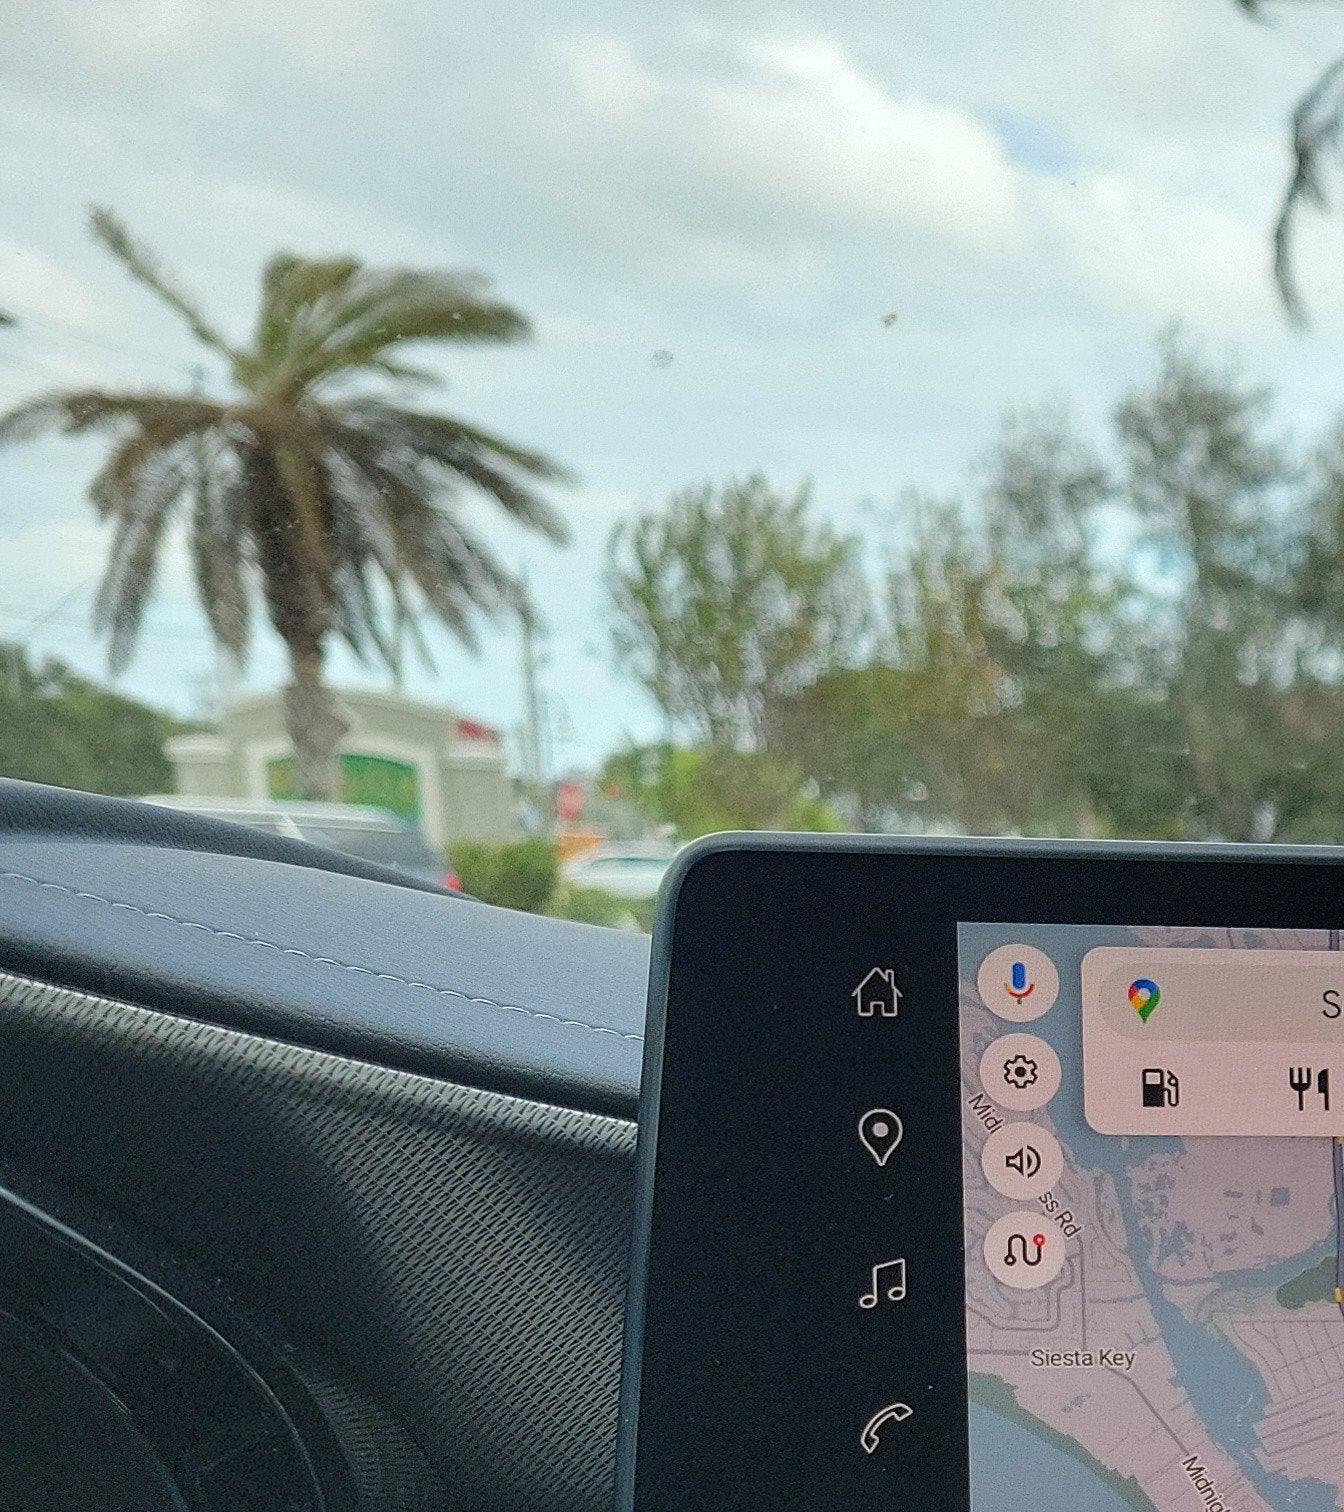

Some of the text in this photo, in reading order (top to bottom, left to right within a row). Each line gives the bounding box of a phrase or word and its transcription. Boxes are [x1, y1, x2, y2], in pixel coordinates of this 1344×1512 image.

[1055, 1210, 1082, 1238] Rd
[1031, 1349, 1135, 1371] Siesta Key
